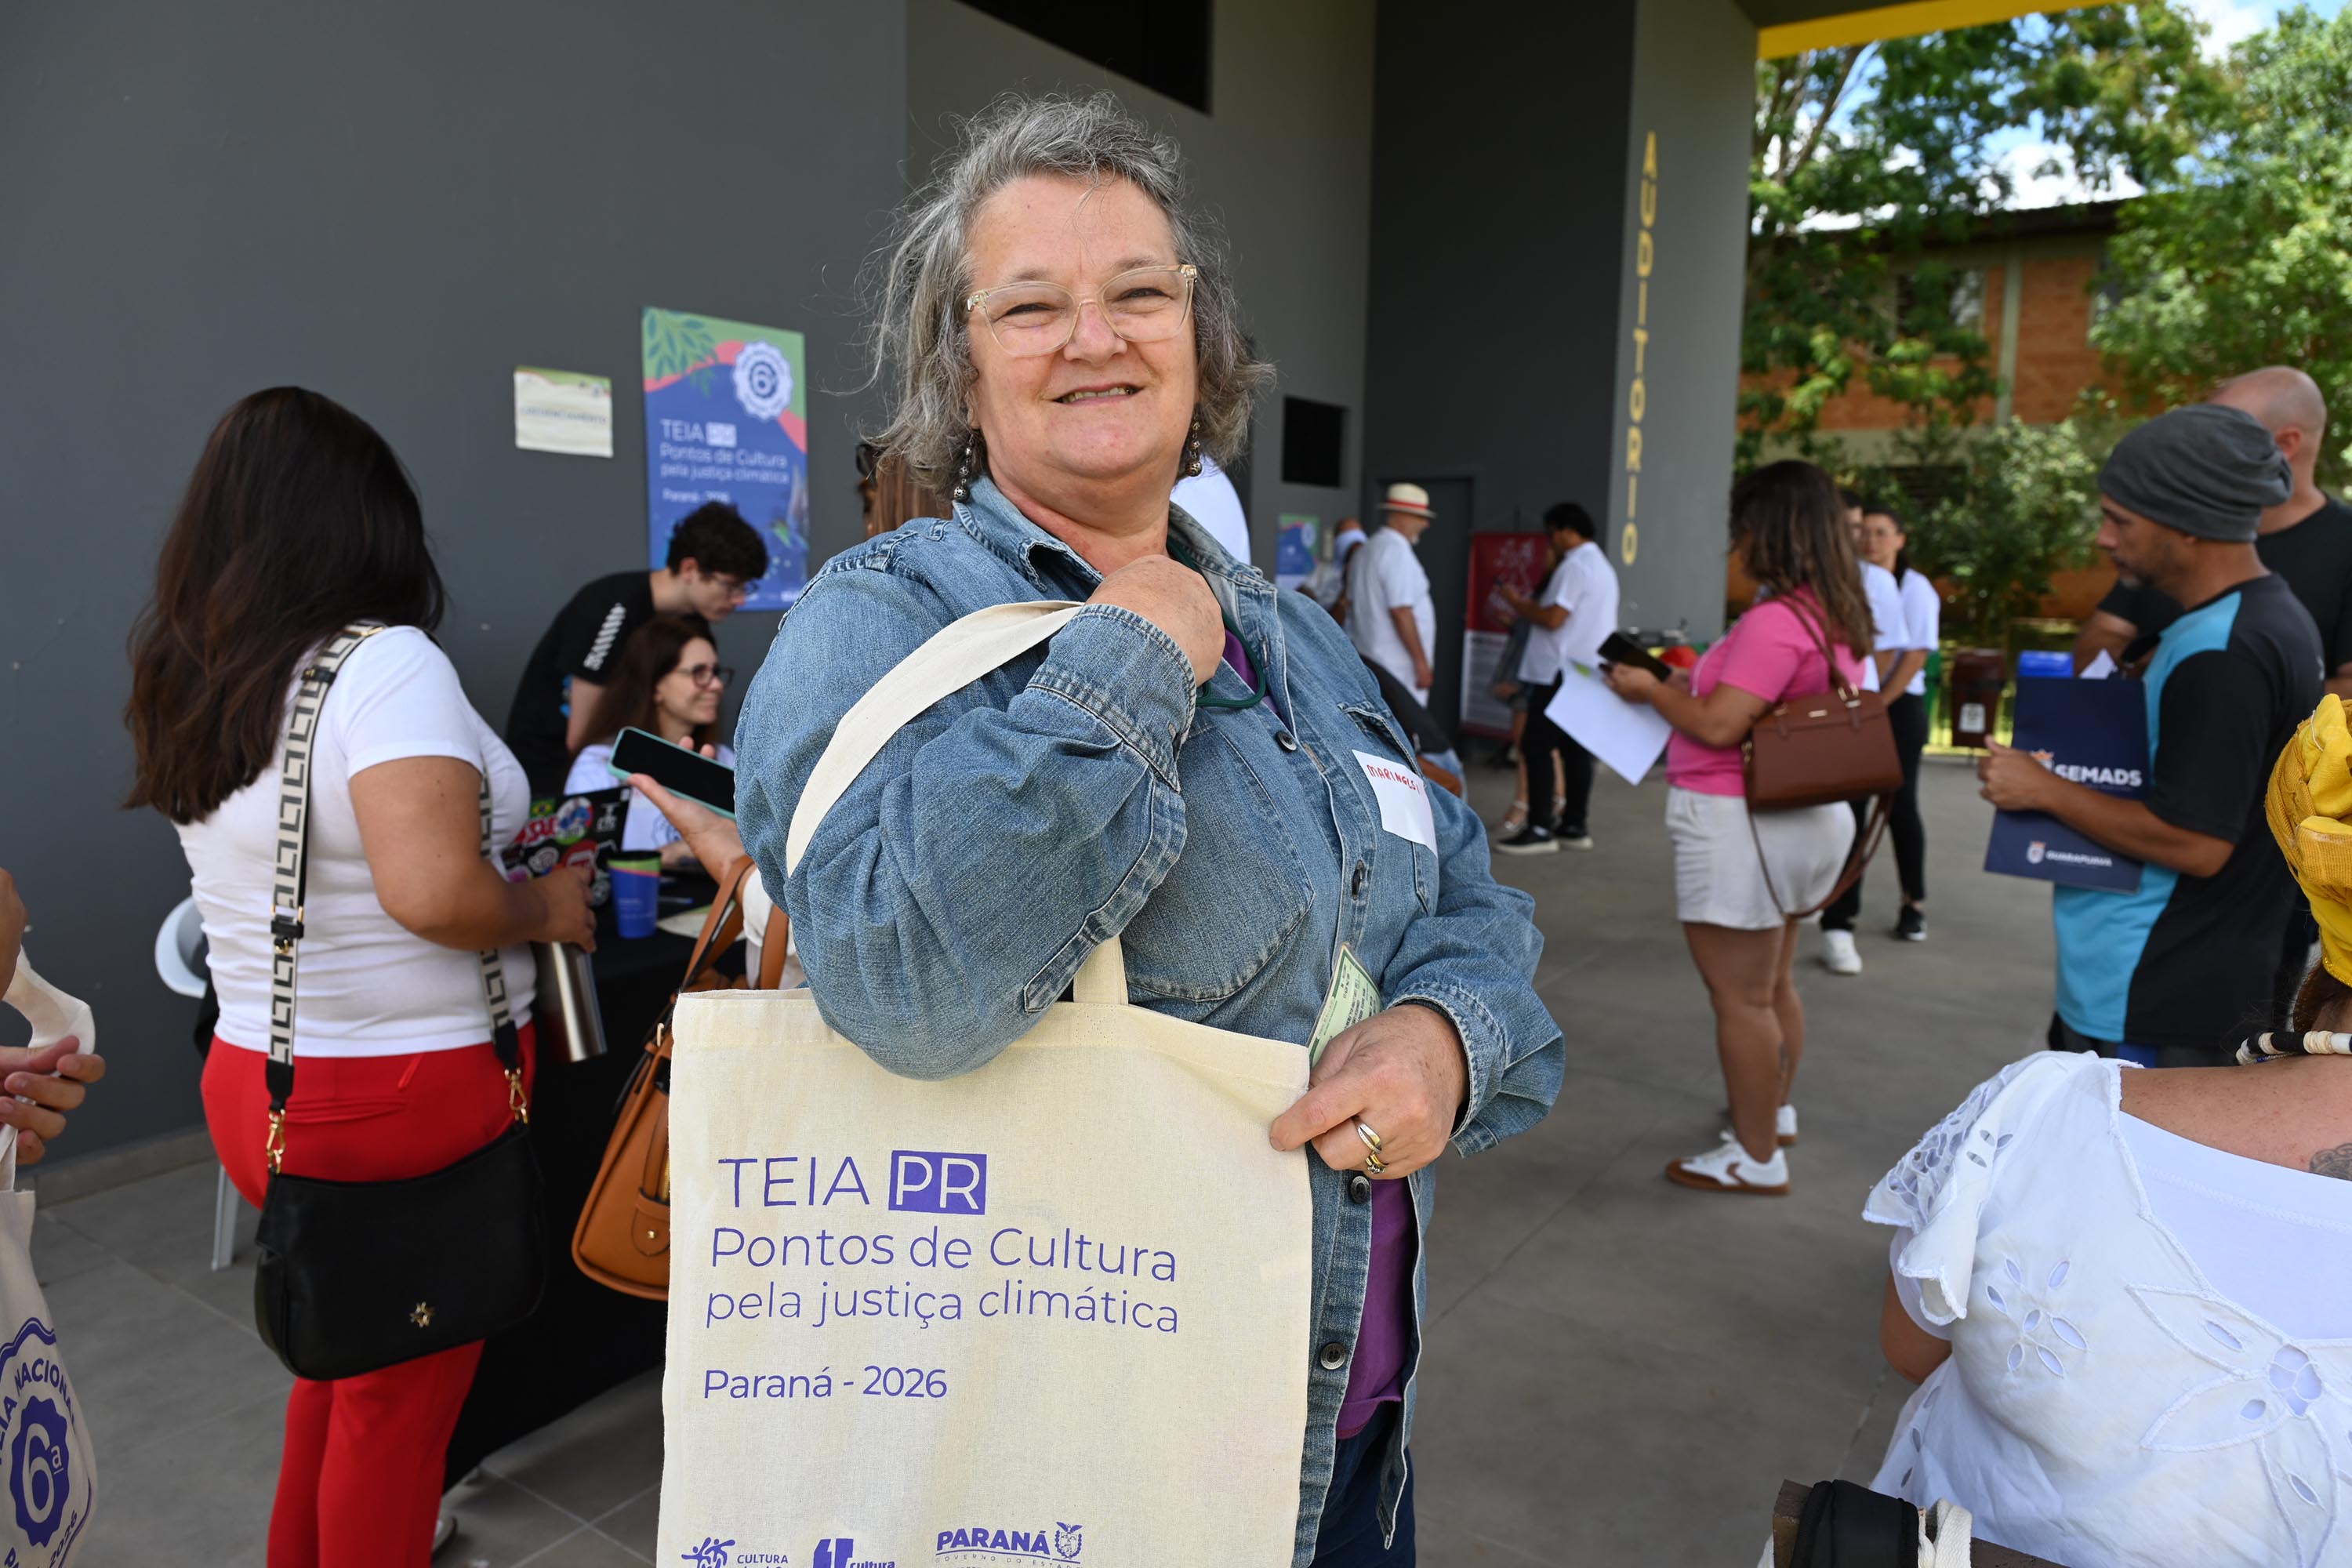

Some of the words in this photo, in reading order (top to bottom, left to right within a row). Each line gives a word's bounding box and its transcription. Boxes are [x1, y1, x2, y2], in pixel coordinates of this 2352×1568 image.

[1621, 131, 1658, 566] AUDITORIO
[660, 419, 706, 444] TEIA
[660, 443, 712, 463] Pontos
[714, 449, 734, 465] de
[735, 449, 788, 469] Cultura
[661, 464, 689, 478] pela
[2055, 764, 2142, 786] SEMADS
[718, 1156, 870, 1207] TEIA
[895, 1155, 981, 1210] PR
[712, 1226, 895, 1268] Pontos
[909, 1225, 973, 1269] de
[989, 1227, 1178, 1283] Cultura
[706, 1281, 801, 1328] pela
[811, 1280, 963, 1329] justiça
[978, 1279, 1179, 1334] climática
[703, 1367, 833, 1399] Paraná
[863, 1365, 949, 1399] 2026
[937, 1527, 1051, 1555] PARANÁ
[736, 1554, 789, 1564] CULTURA
[935, 1554, 996, 1563] GOVERNO
